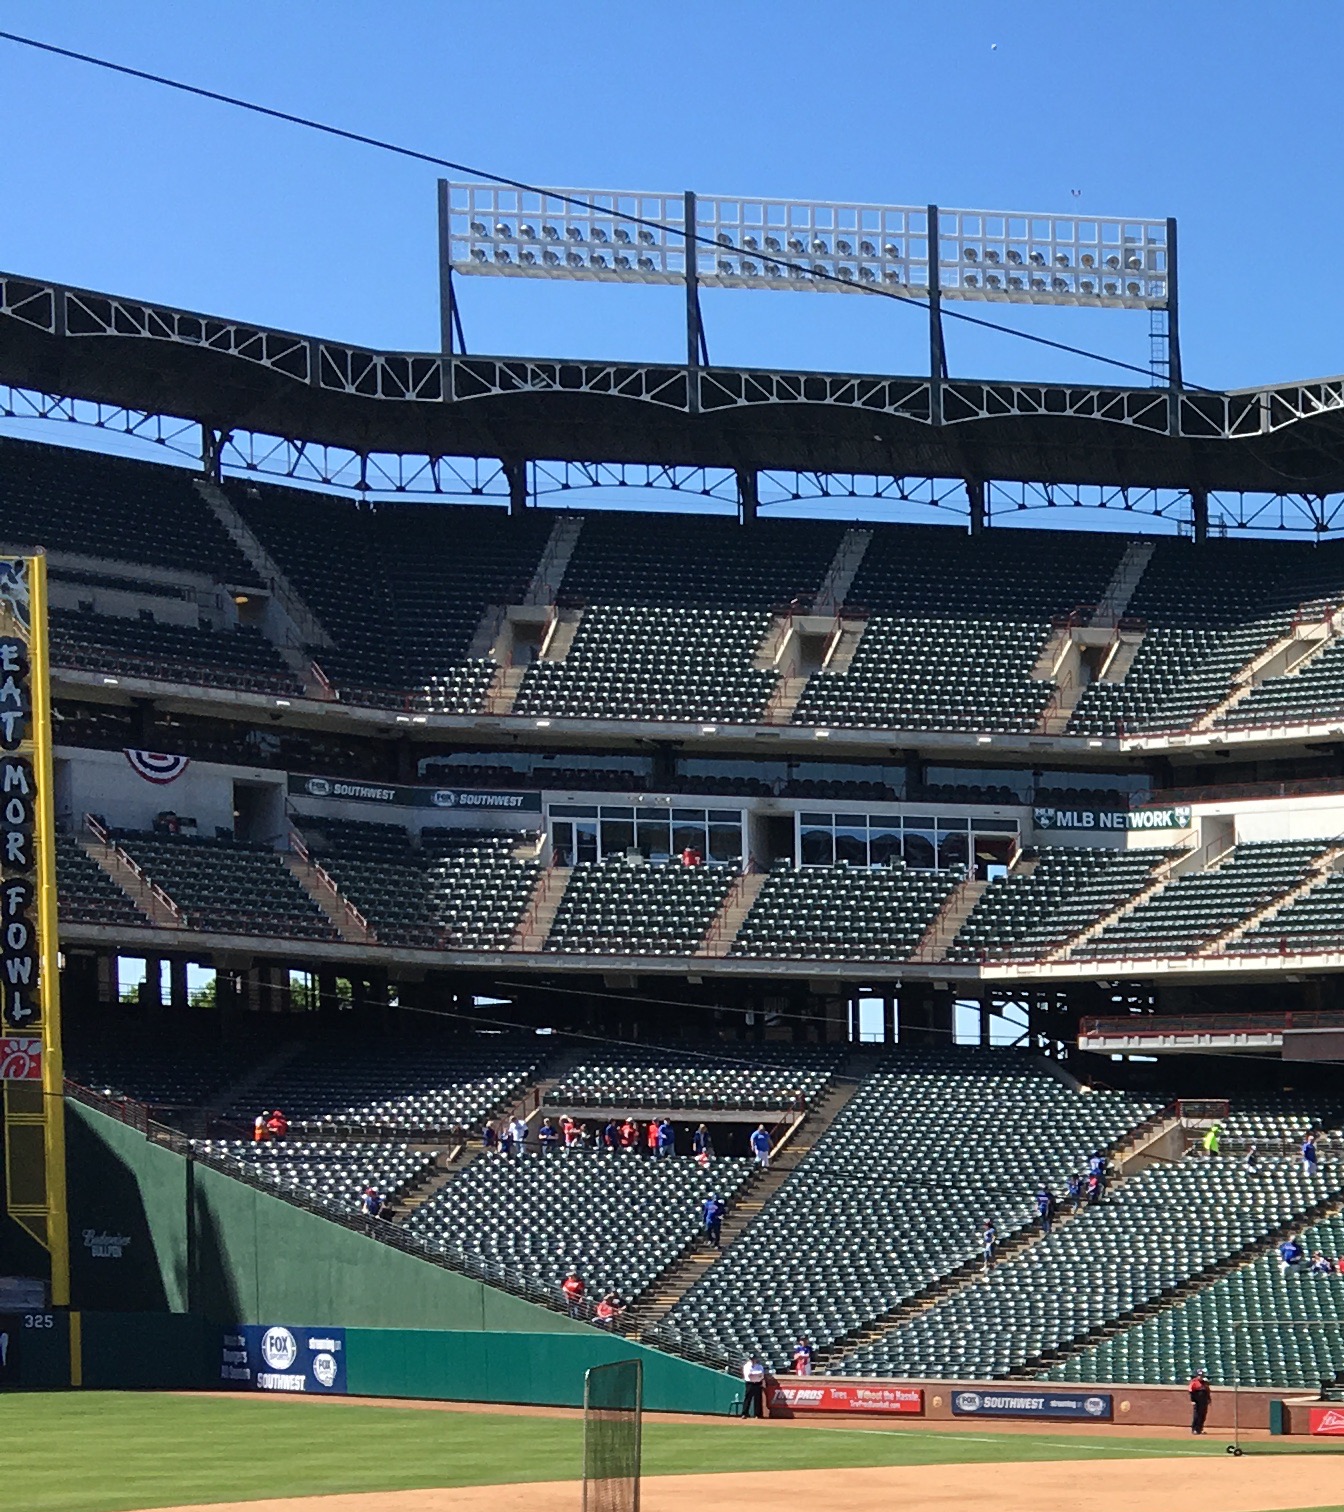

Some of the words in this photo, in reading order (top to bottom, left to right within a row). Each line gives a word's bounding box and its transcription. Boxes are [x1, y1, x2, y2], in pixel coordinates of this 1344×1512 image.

[0, 644, 24, 742] EAT
[333, 783, 396, 801] SOUTHWEST
[459, 794, 524, 807] SOUTHWEST
[4, 764, 29, 865] MOR
[1056, 811, 1095, 828] MLB
[1099, 810, 1173, 828] NETWORK
[6, 886, 32, 1021] FOWL
[24, 1314, 54, 1328] 325
[269, 1335, 289, 1354] FOX
[257, 1373, 306, 1391] SOUTHWEST
[983, 1397, 1045, 1410] SOUTHWEST
